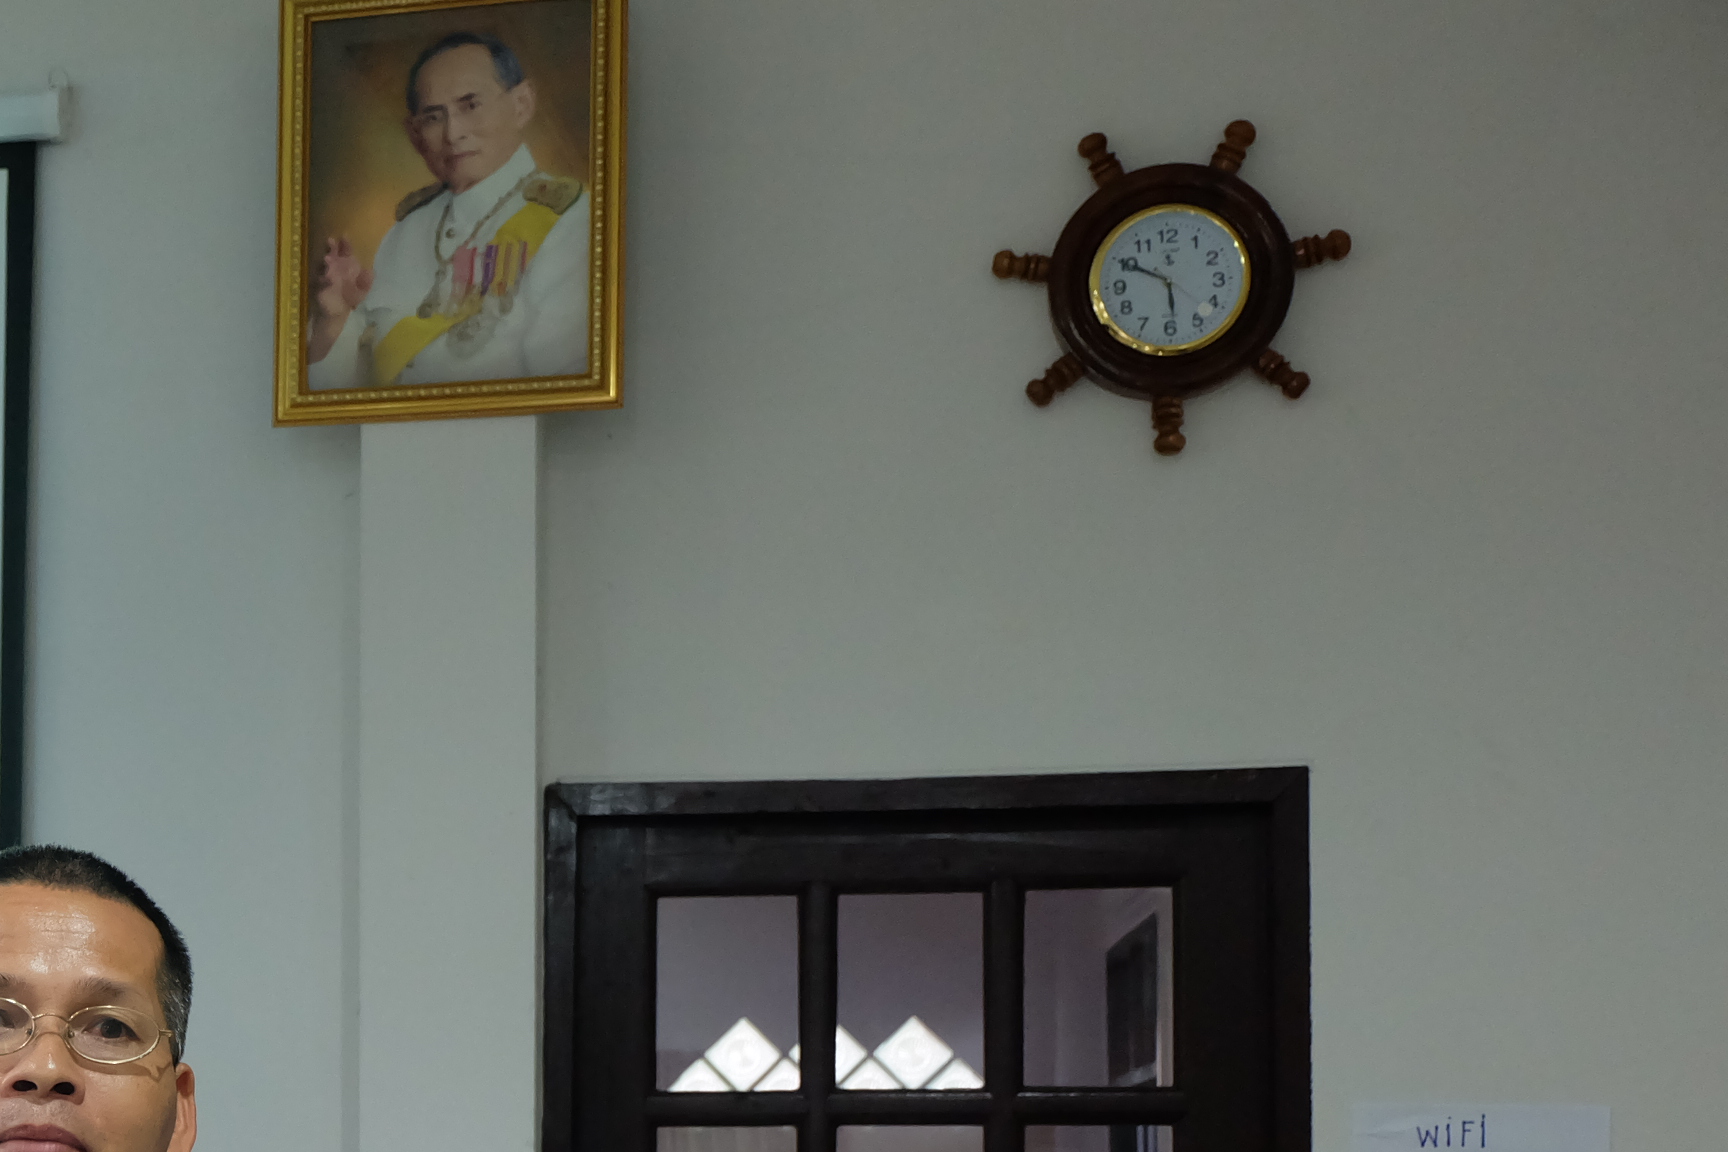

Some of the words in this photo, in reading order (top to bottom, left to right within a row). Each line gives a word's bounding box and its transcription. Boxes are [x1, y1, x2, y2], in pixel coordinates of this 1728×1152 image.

[1158, 228, 1179, 244] 12
[1191, 235, 1199, 249] 1
[1134, 238, 1151, 253] 11
[1206, 250, 1219, 266] 2
[1113, 279, 1127, 295] 9
[1212, 271, 1226, 288] 3
[1120, 300, 1133, 315] 8
[1208, 294, 1219, 308] 4
[1137, 317, 1150, 331] 7
[1164, 320, 1177, 336] 6
[1192, 313, 1204, 328] 5
